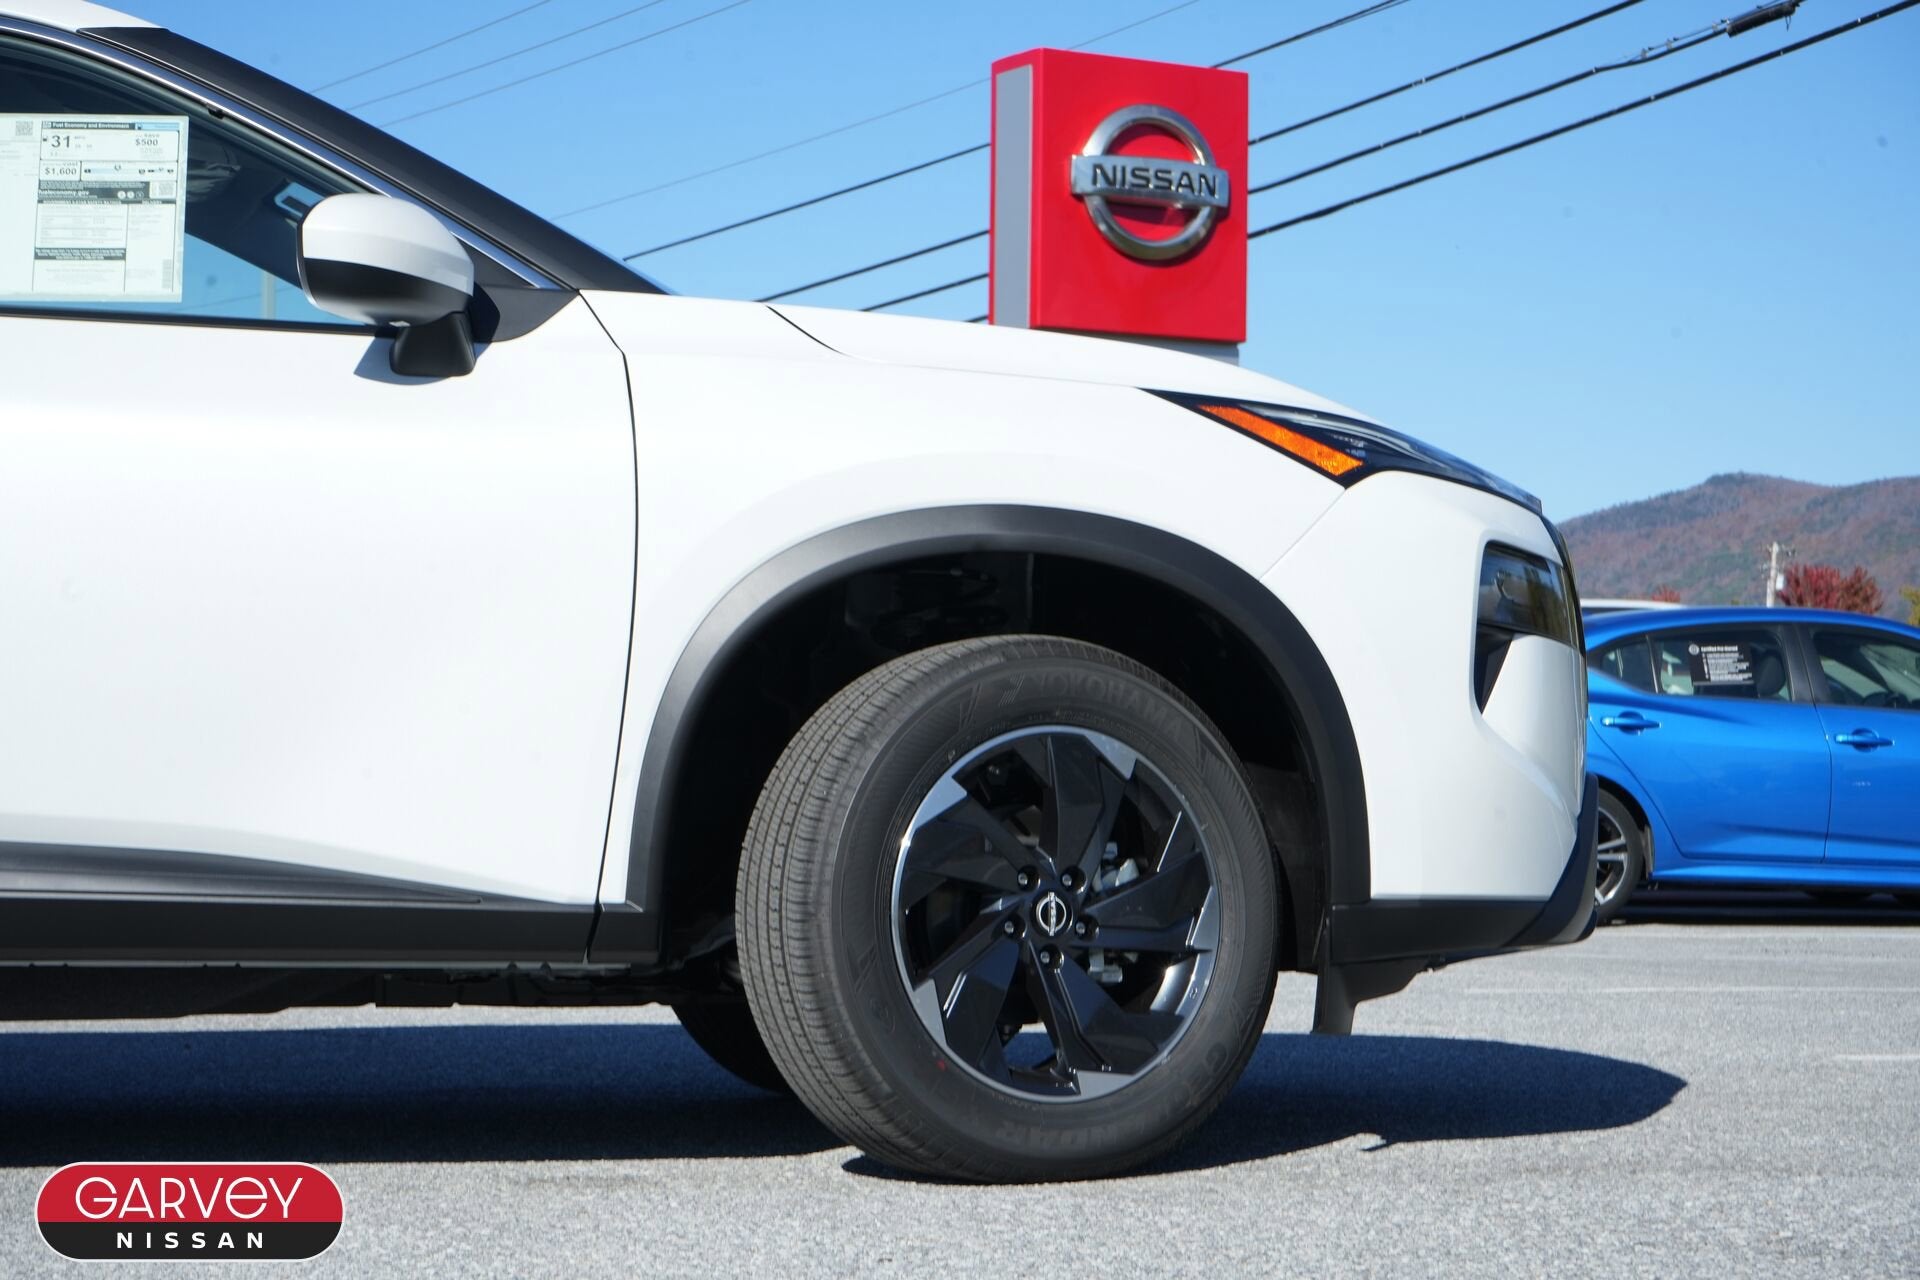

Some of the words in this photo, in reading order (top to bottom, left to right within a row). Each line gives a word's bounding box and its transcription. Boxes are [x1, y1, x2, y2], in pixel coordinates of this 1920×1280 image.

[51, 135, 70, 148] 31
[135, 138, 159, 147] $500
[44, 167, 77, 176] $1,600
[1091, 163, 1217, 199] NISSAN
[1034, 671, 1184, 742] YOKOHAMA
